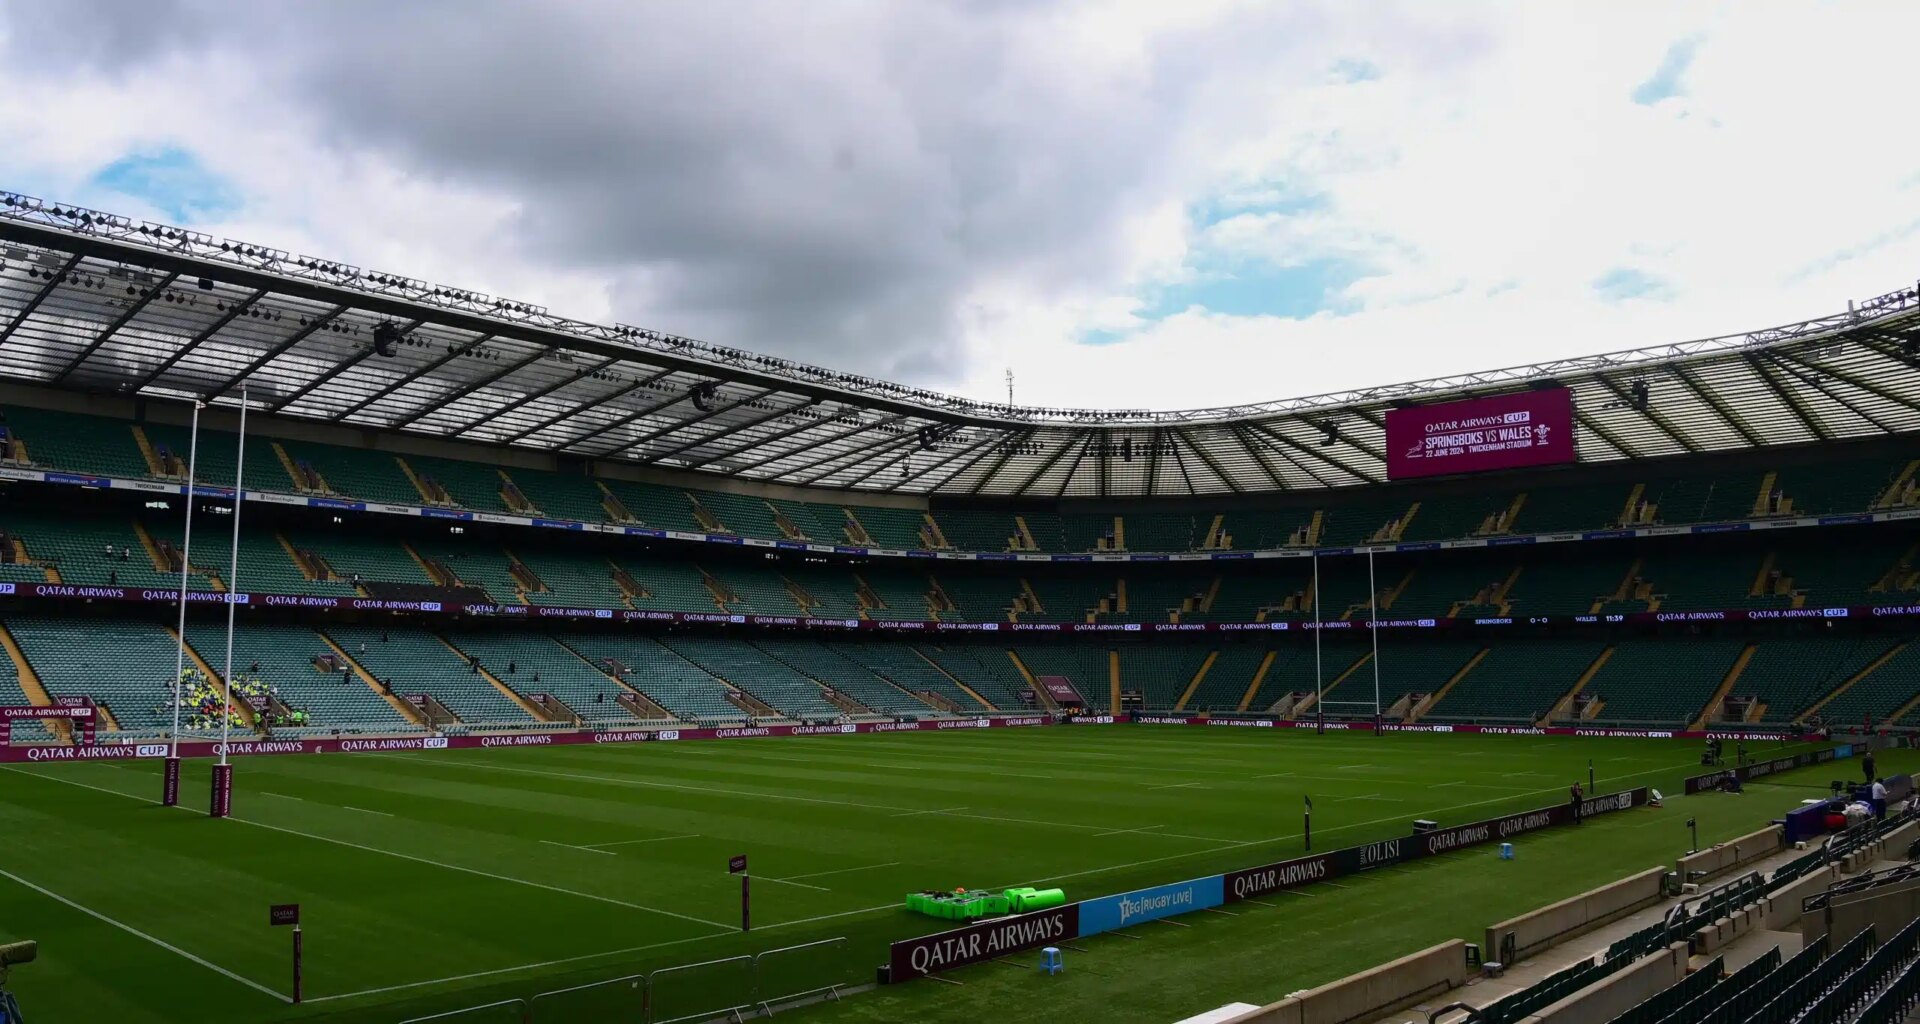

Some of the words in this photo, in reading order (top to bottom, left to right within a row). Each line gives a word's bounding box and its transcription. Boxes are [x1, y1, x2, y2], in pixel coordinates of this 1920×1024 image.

[1425, 420, 1458, 433] QATAR
[1460, 415, 1502, 428] AIRWAYS
[1506, 412, 1528, 422] CUP
[1425, 431, 1483, 449] SPRINGBOKS
[1485, 430, 1497, 442] VS
[1499, 426, 1532, 441] WALES
[1425, 450, 1433, 458] 22
[1434, 449, 1448, 457] JUNE
[1449, 447, 1465, 456] 2024
[1469, 442, 1506, 454] TWICKENHAM
[1506, 439, 1532, 449] STADIUM
[36, 585, 75, 596] QATAR
[77, 588, 124, 598] AIRWAYS
[143, 590, 178, 600] QATAR
[181, 592, 223, 602] AIRWAYS
[227, 594, 247, 602] CUP
[266, 596, 298, 606] QATAR
[299, 598, 338, 607] AIRWAYS
[353, 599, 383, 609] QATAR
[384, 601, 420, 610] AIRWAYS
[540, 607, 564, 616] QATAR
[565, 609, 594, 617] AIRWAYS
[624, 611, 645, 619] QATAR
[647, 612, 674, 620] AIRWAYS
[1657, 613, 1685, 621] QATAR
[1687, 611, 1725, 620] AIRWAYS
[1749, 611, 1779, 619] QATAR
[1782, 609, 1823, 618] AIRWAYS
[1873, 607, 1904, 616] QATAR
[684, 613, 704, 622] QATAR
[705, 614, 730, 622] AIRWAYS
[754, 616, 773, 624] QATAR
[773, 617, 797, 625] AIRWAYS
[806, 618, 823, 626] QATAR
[824, 619, 845, 627] AIRWAYS
[879, 621, 899, 629] QATAR
[1178, 623, 1205, 631] AIRWAYS
[1220, 623, 1242, 631] QATAR
[1324, 621, 1351, 629] AIRWAYS
[1365, 620, 1388, 629] QATAR
[61, 697, 83, 705] QATAR
[937, 721, 955, 729] QATAR
[956, 720, 977, 728] AIRWAYS
[1006, 718, 1022, 726] QATAR
[1160, 717, 1188, 725] AIRWAYS
[792, 726, 814, 735] QATAR
[814, 725, 841, 733] AIRWAYS
[876, 723, 895, 732] QATAR
[896, 722, 919, 730] AIRWAYS
[595, 733, 623, 743] QATAR
[661, 731, 677, 739] CUP
[716, 729, 739, 738] QATAR
[740, 728, 769, 737] AIRWAYS
[342, 740, 378, 751] QATAR
[380, 738, 422, 749] AIRWAYS
[426, 738, 445, 747] CUP
[481, 736, 513, 747] QATAR
[514, 735, 551, 745] AIRWAYS
[27, 748, 74, 761] QATAR
[77, 746, 133, 758] AIRWAYS
[139, 745, 165, 755] CUP
[212, 743, 252, 755] QATAR
[255, 742, 303, 753] AIRWAYS
[1575, 799, 1594, 818] ATAR
[1595, 796, 1618, 814] AIRWAYS
[1620, 793, 1631, 808] CUP
[1500, 817, 1522, 837] QATAR
[1524, 811, 1550, 830] AIRWAYS
[1429, 832, 1455, 854] QATAR
[1457, 825, 1488, 845] AIRWAYS
[1368, 839, 1400, 862] OLISI
[1234, 869, 1276, 898] QATAR
[1278, 859, 1325, 885] AIRWAYS
[911, 933, 981, 975] QATAR
[986, 913, 1063, 953] AIRWAYS
